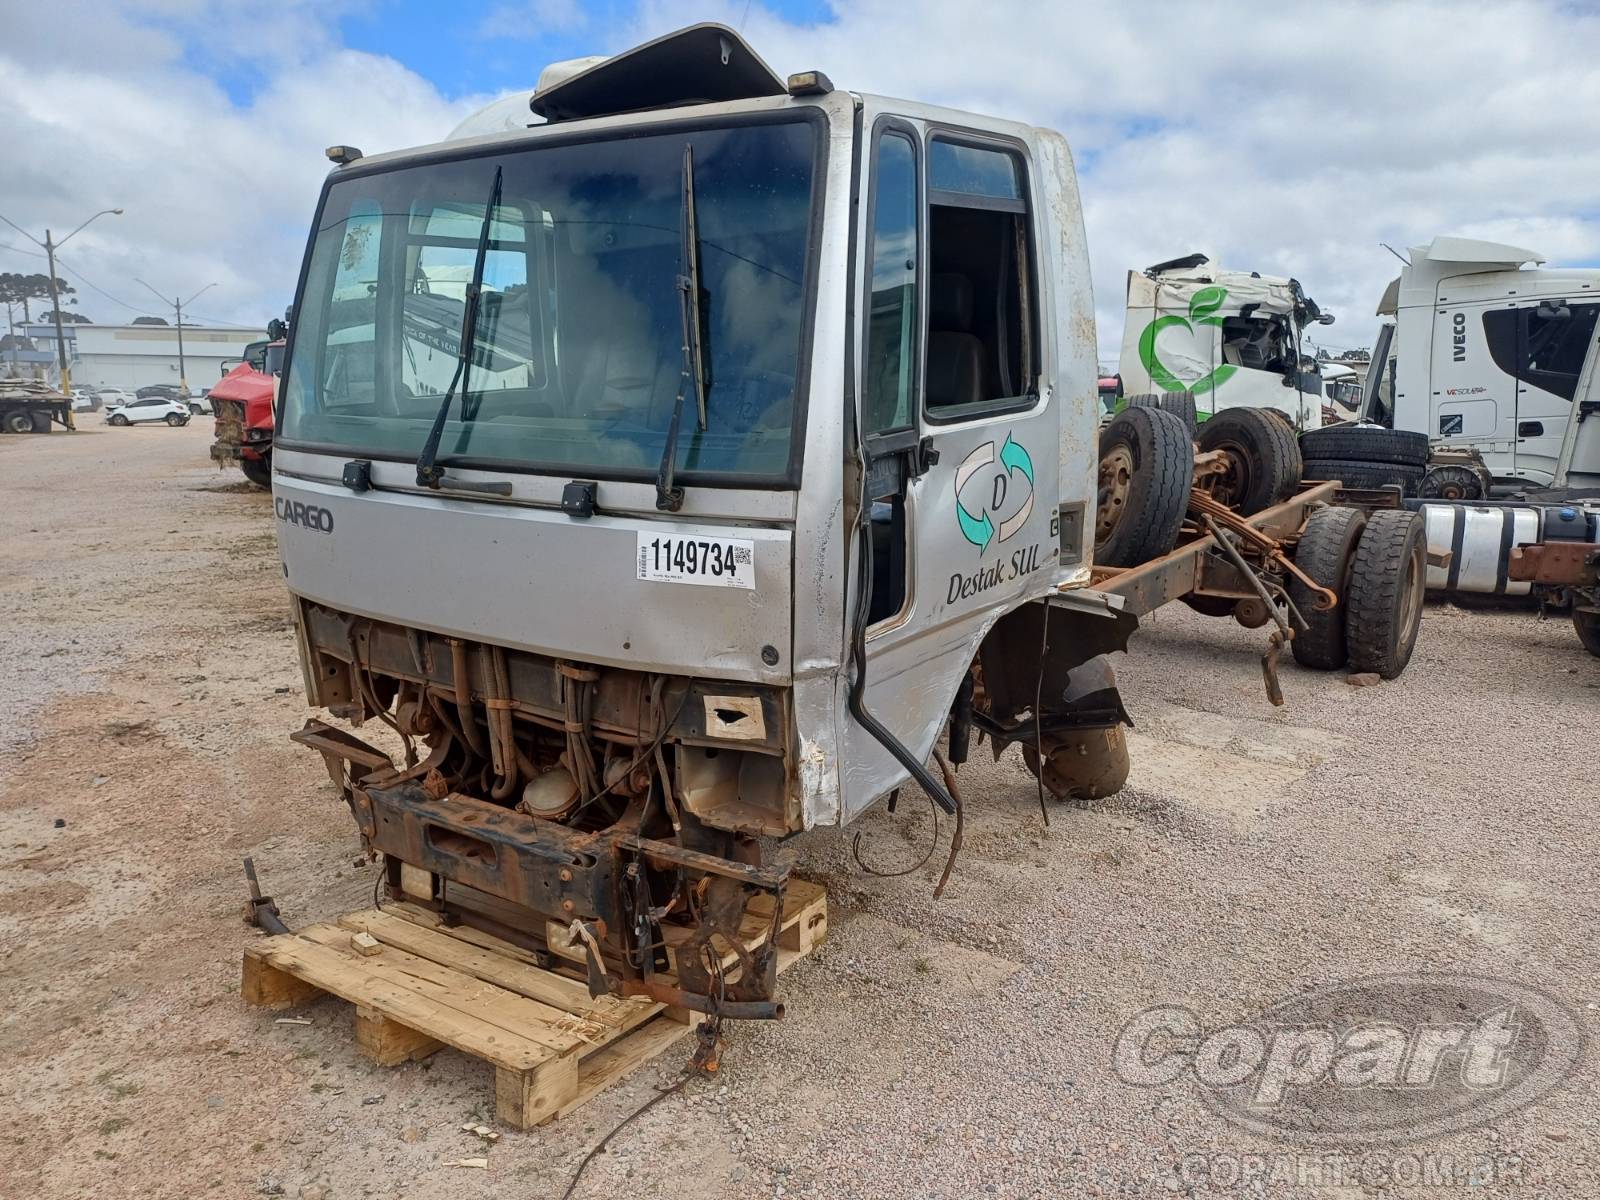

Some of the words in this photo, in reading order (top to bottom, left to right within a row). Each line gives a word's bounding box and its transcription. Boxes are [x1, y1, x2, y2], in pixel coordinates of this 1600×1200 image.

[1453, 313, 1466, 362] IVECO
[991, 473, 1007, 512] D
[275, 496, 334, 535] CARGO
[651, 538, 737, 577] 1149734
[946, 558, 1005, 605] Destak
[1007, 543, 1041, 581] SUL
